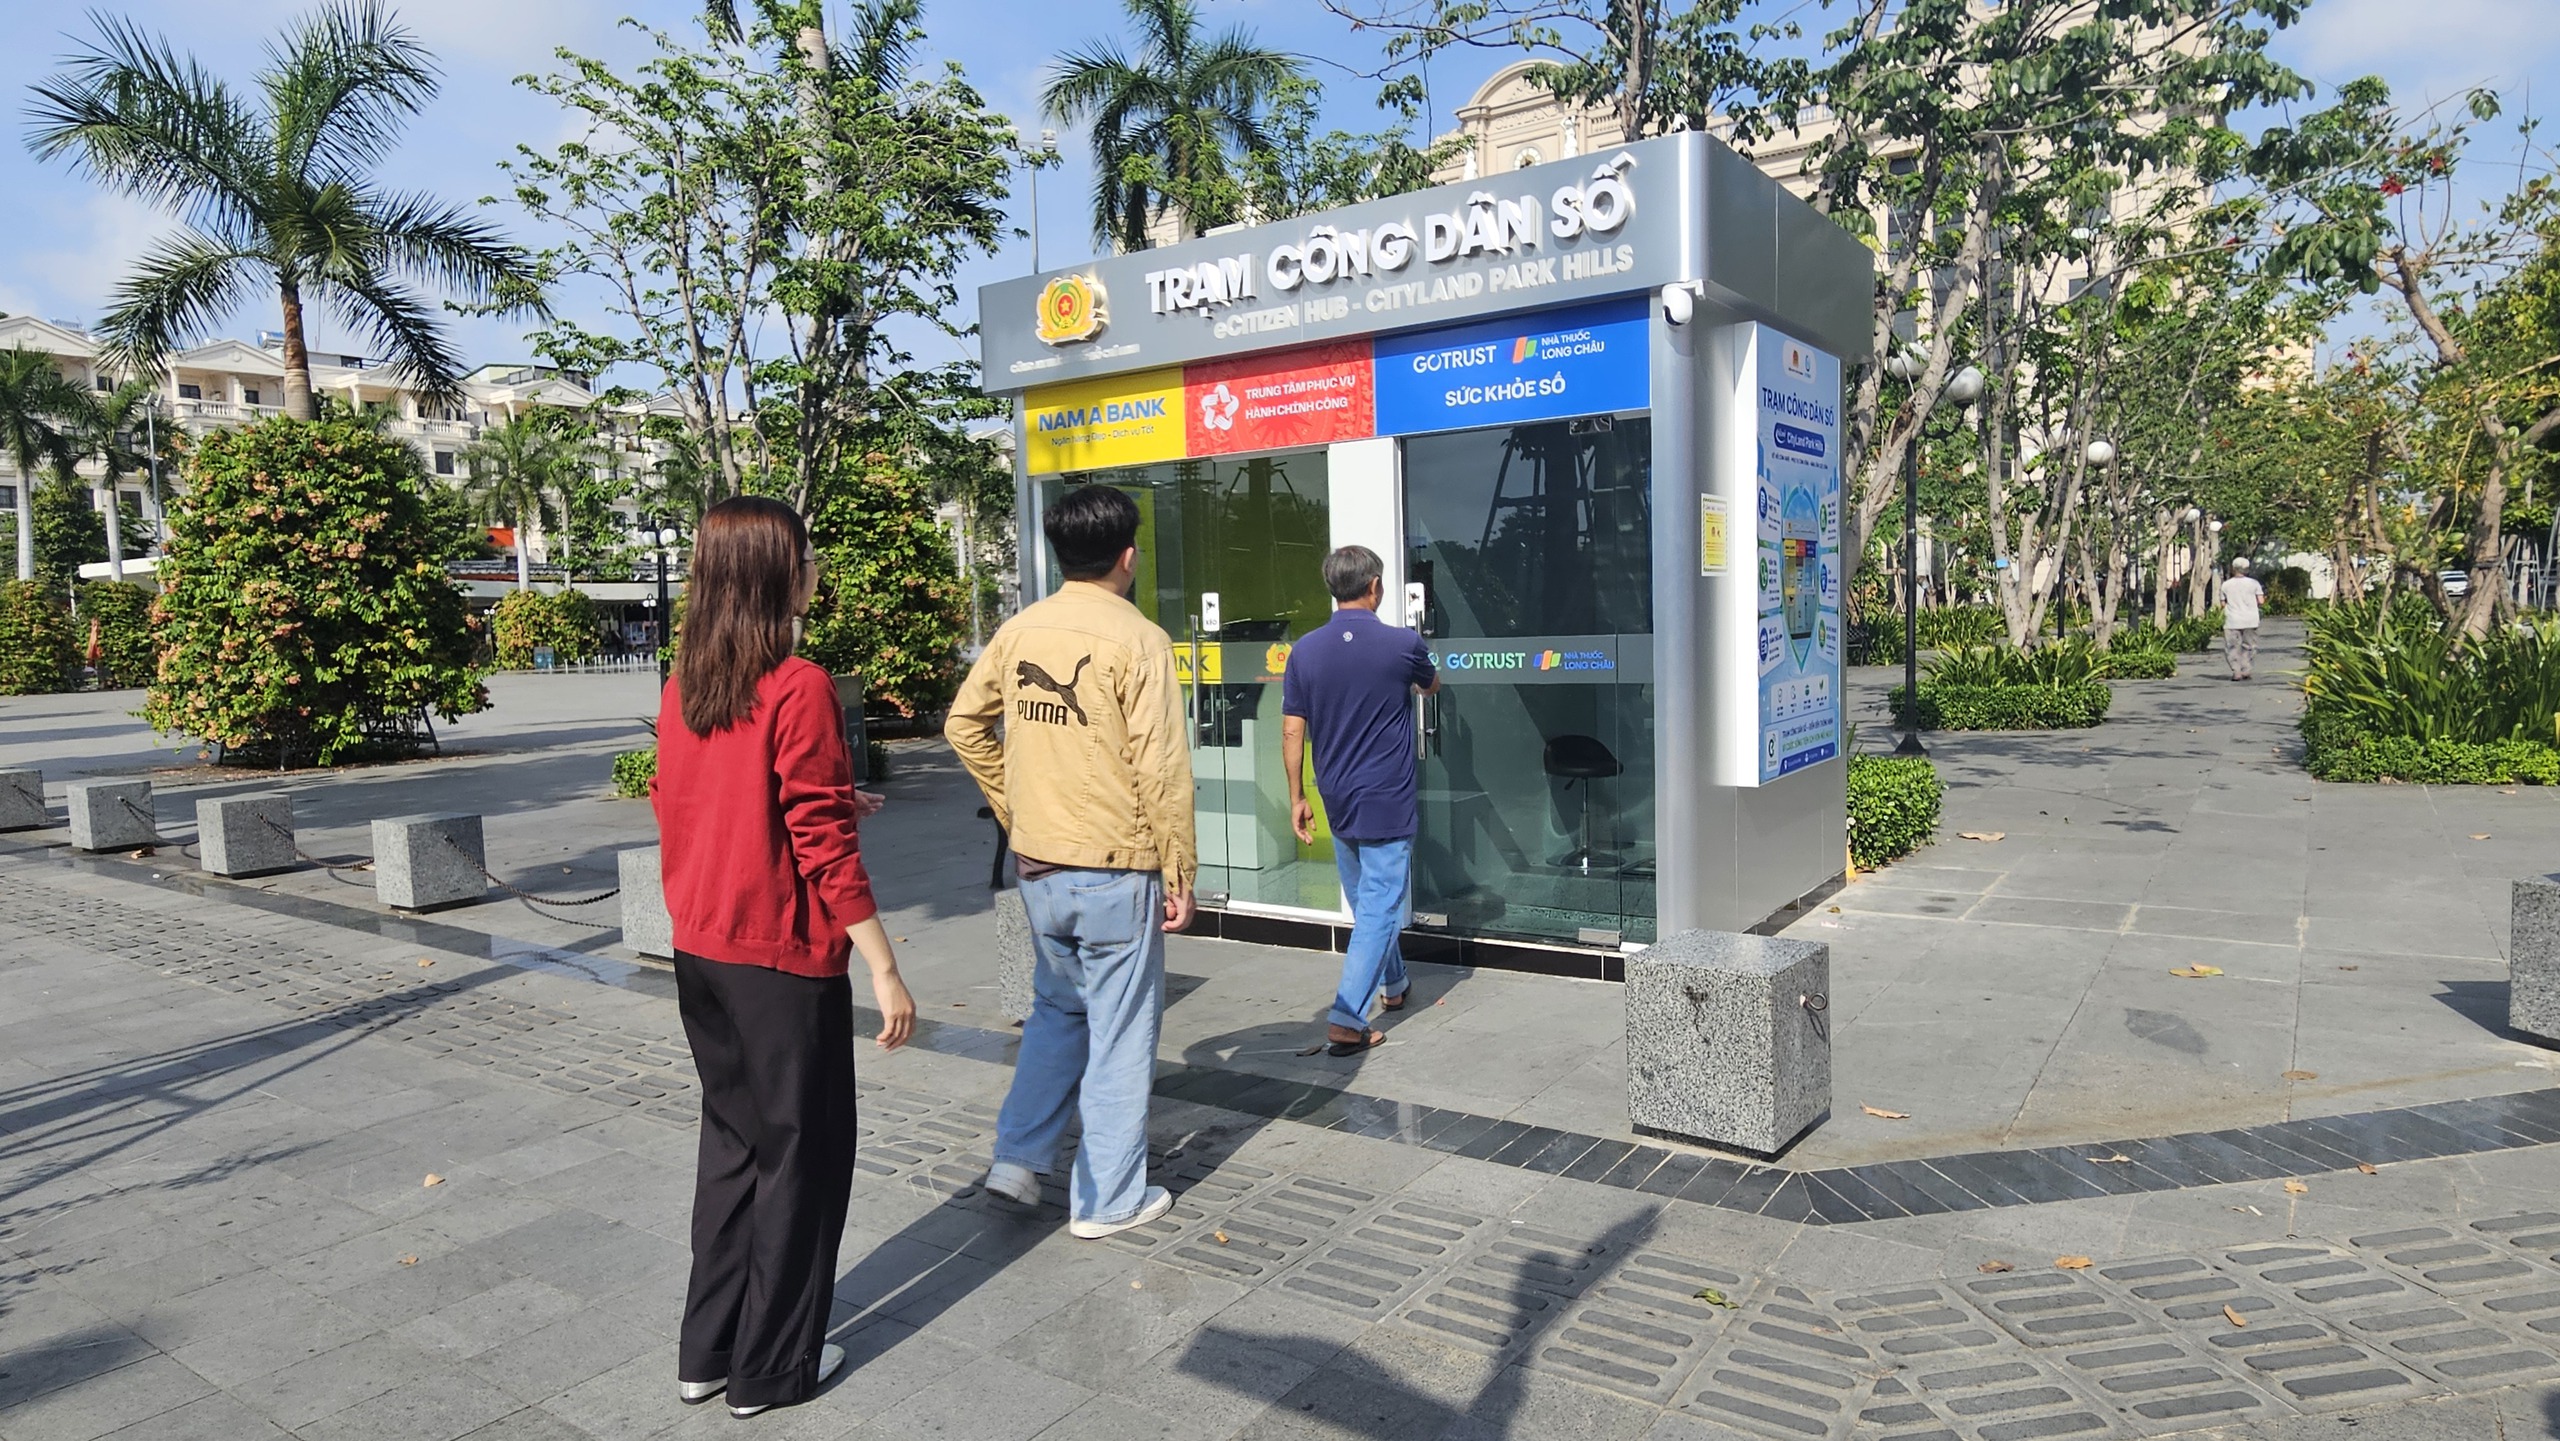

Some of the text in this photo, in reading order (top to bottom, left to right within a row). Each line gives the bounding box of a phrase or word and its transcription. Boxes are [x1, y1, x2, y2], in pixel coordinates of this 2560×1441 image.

[1145, 151, 1634, 318] TRẠM CÔNG DÂN SỐ
[1213, 304, 1299, 339] eCITIZEN
[1304, 296, 1349, 324] HUB
[1365, 272, 1484, 313] CITYLAND
[1489, 257, 1557, 293] PARK
[1563, 244, 1634, 281] HILLS
[1541, 329, 1591, 346] NHÀ THUỐC
[1541, 340, 1605, 360] LONG CHÂU
[1413, 345, 1497, 374] GOTRUST
[1245, 374, 1356, 400] TRUNG TÂM PHỤC VỤ
[1445, 371, 1566, 407] SỨC KHỎE SỐ
[1038, 397, 1166, 432] NAM A BANK
[1245, 396, 1348, 420] HÀNH CHÍNH CÔNG
[1762, 387, 1835, 427] TRẠM CÔNG DÂN SỐ
[1176, 654, 1211, 673] NK
[1446, 652, 1526, 670] GOTRUST
[1564, 659, 1615, 670] LONG CHÂU
[1017, 699, 1068, 726] PUMA
